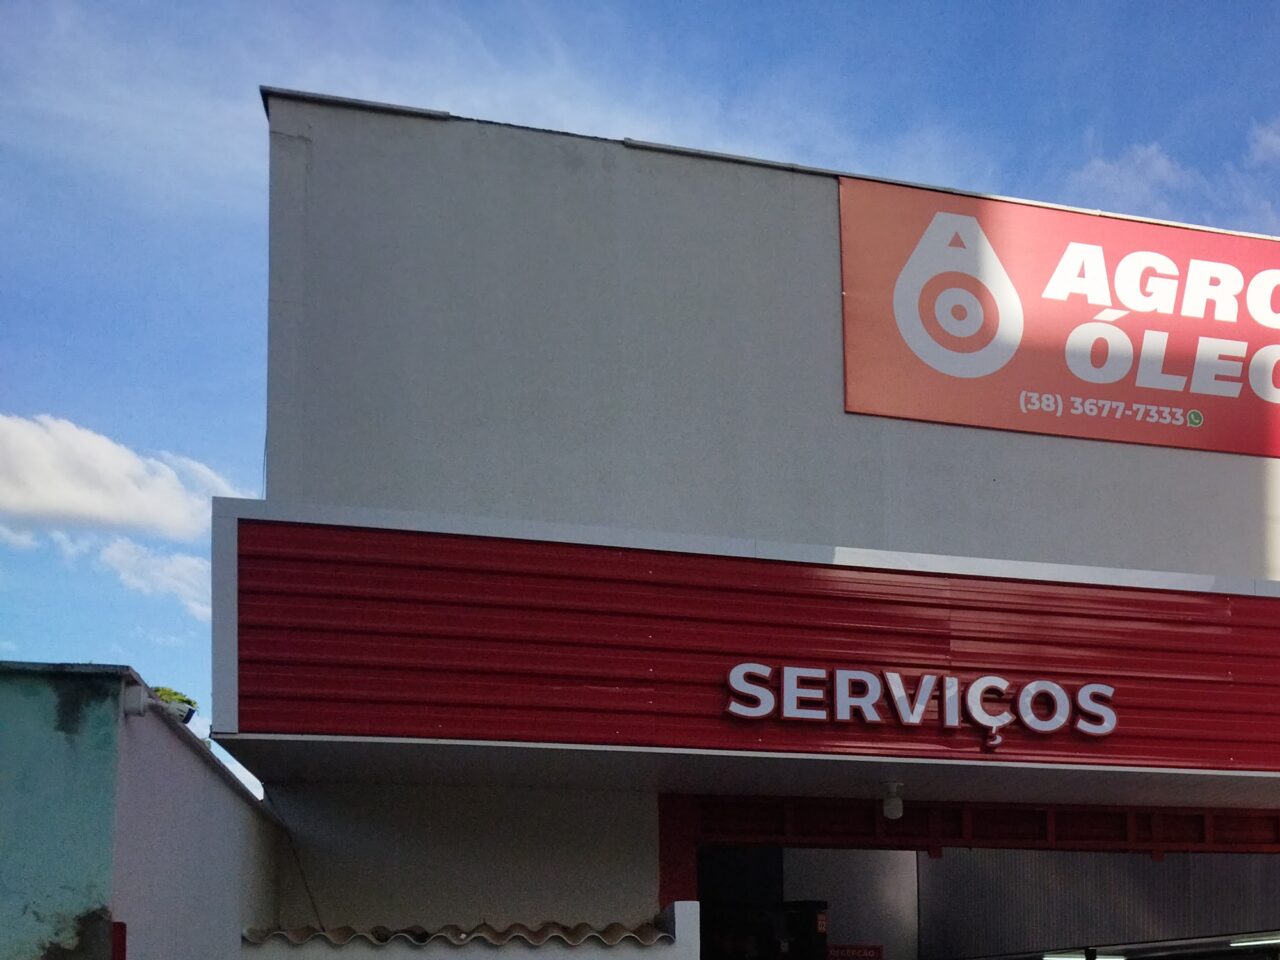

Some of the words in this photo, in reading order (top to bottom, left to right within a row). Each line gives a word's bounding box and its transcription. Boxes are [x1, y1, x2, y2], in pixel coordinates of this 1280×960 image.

[1019, 390, 1063, 417] (38)
[1070, 396, 1185, 426] 3677-7333
[725, 661, 1118, 746] SERVIÇOS
